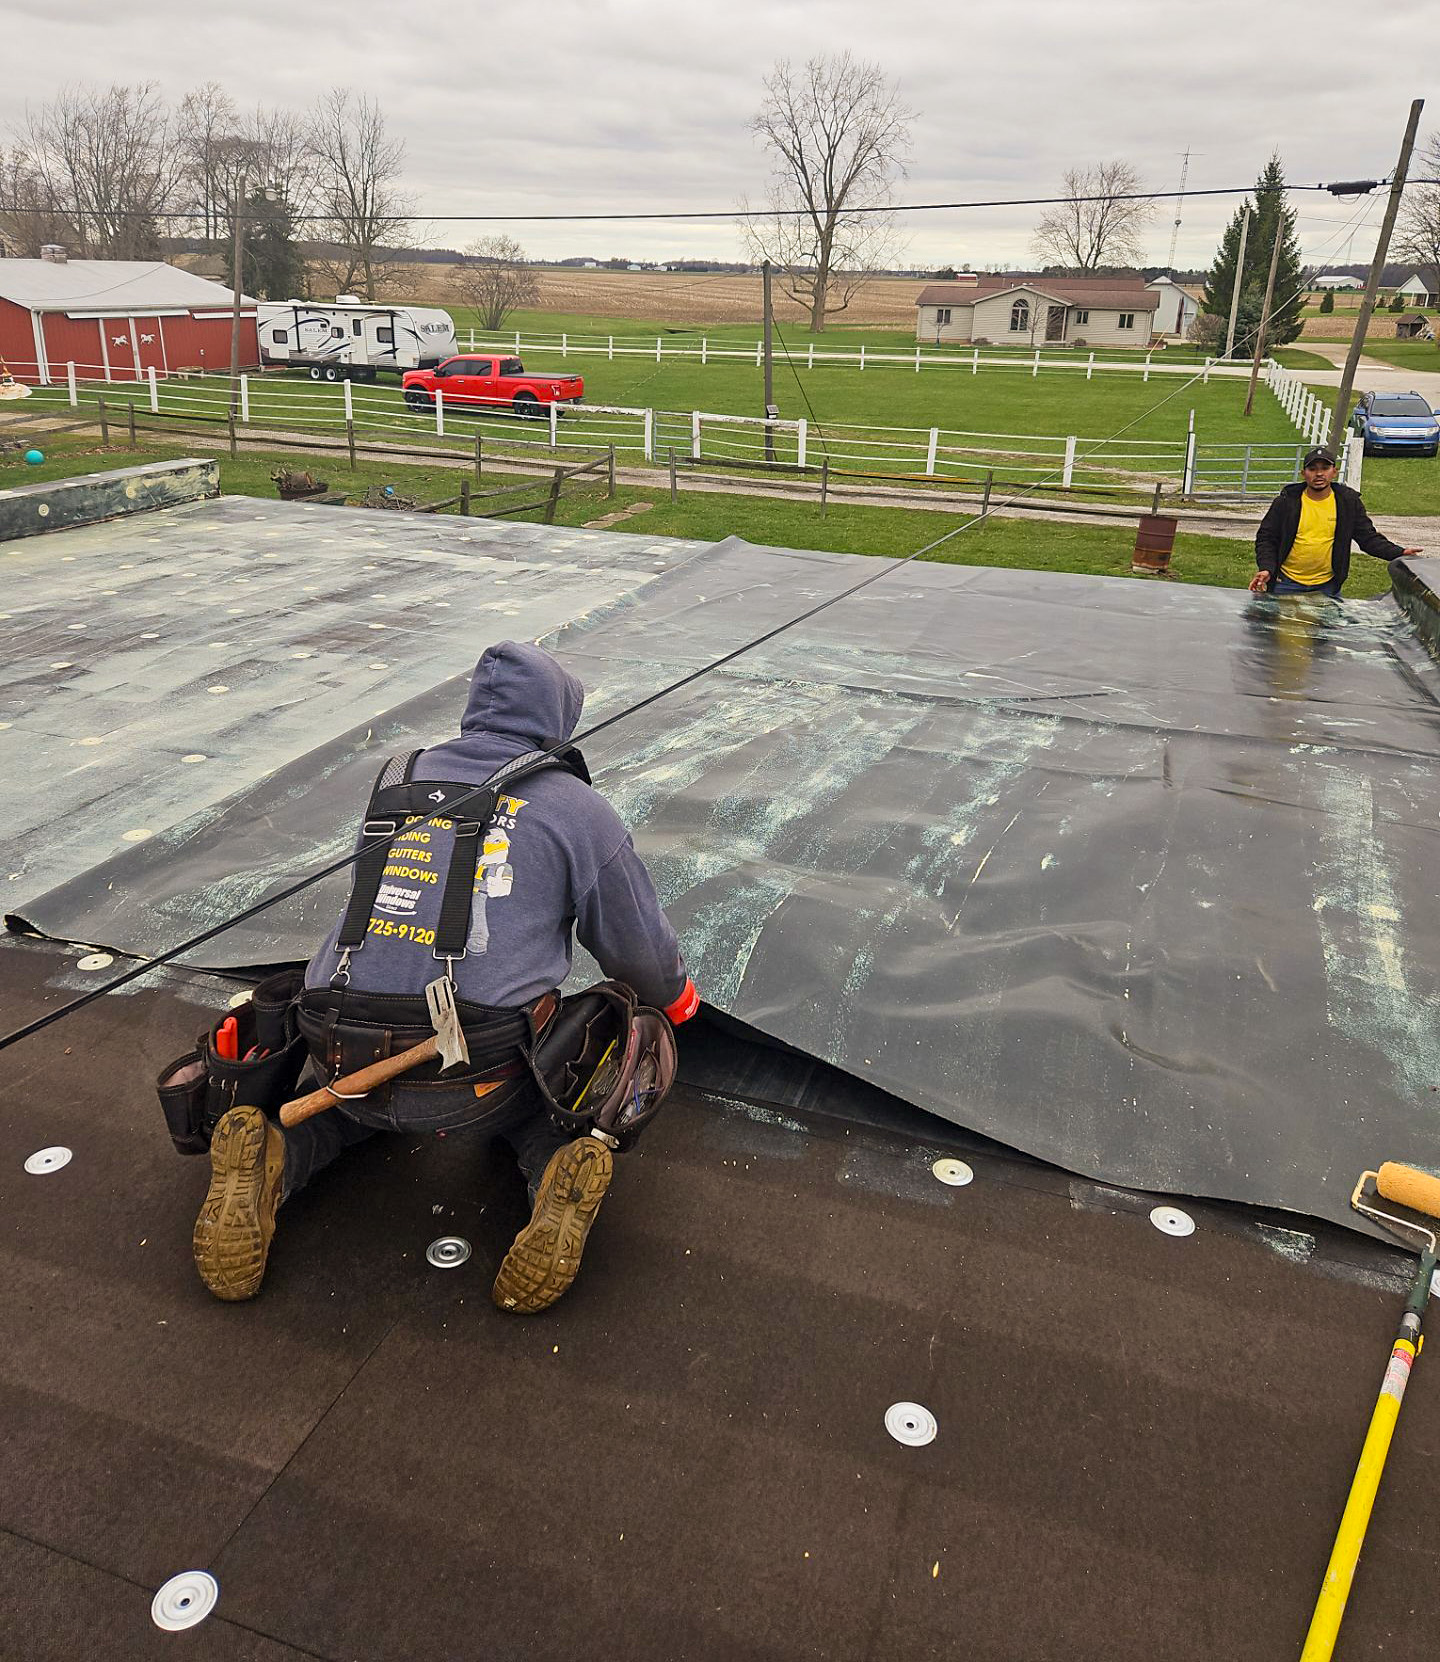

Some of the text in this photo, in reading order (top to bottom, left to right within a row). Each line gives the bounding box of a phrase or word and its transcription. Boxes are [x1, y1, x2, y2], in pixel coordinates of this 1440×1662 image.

[420, 324, 450, 333] SALEM
[387, 848, 433, 863] GUTTERS
[382, 865, 439, 884] WINDOWS
[378, 884, 422, 901] Universal
[366, 917, 436, 945] 725-9120
